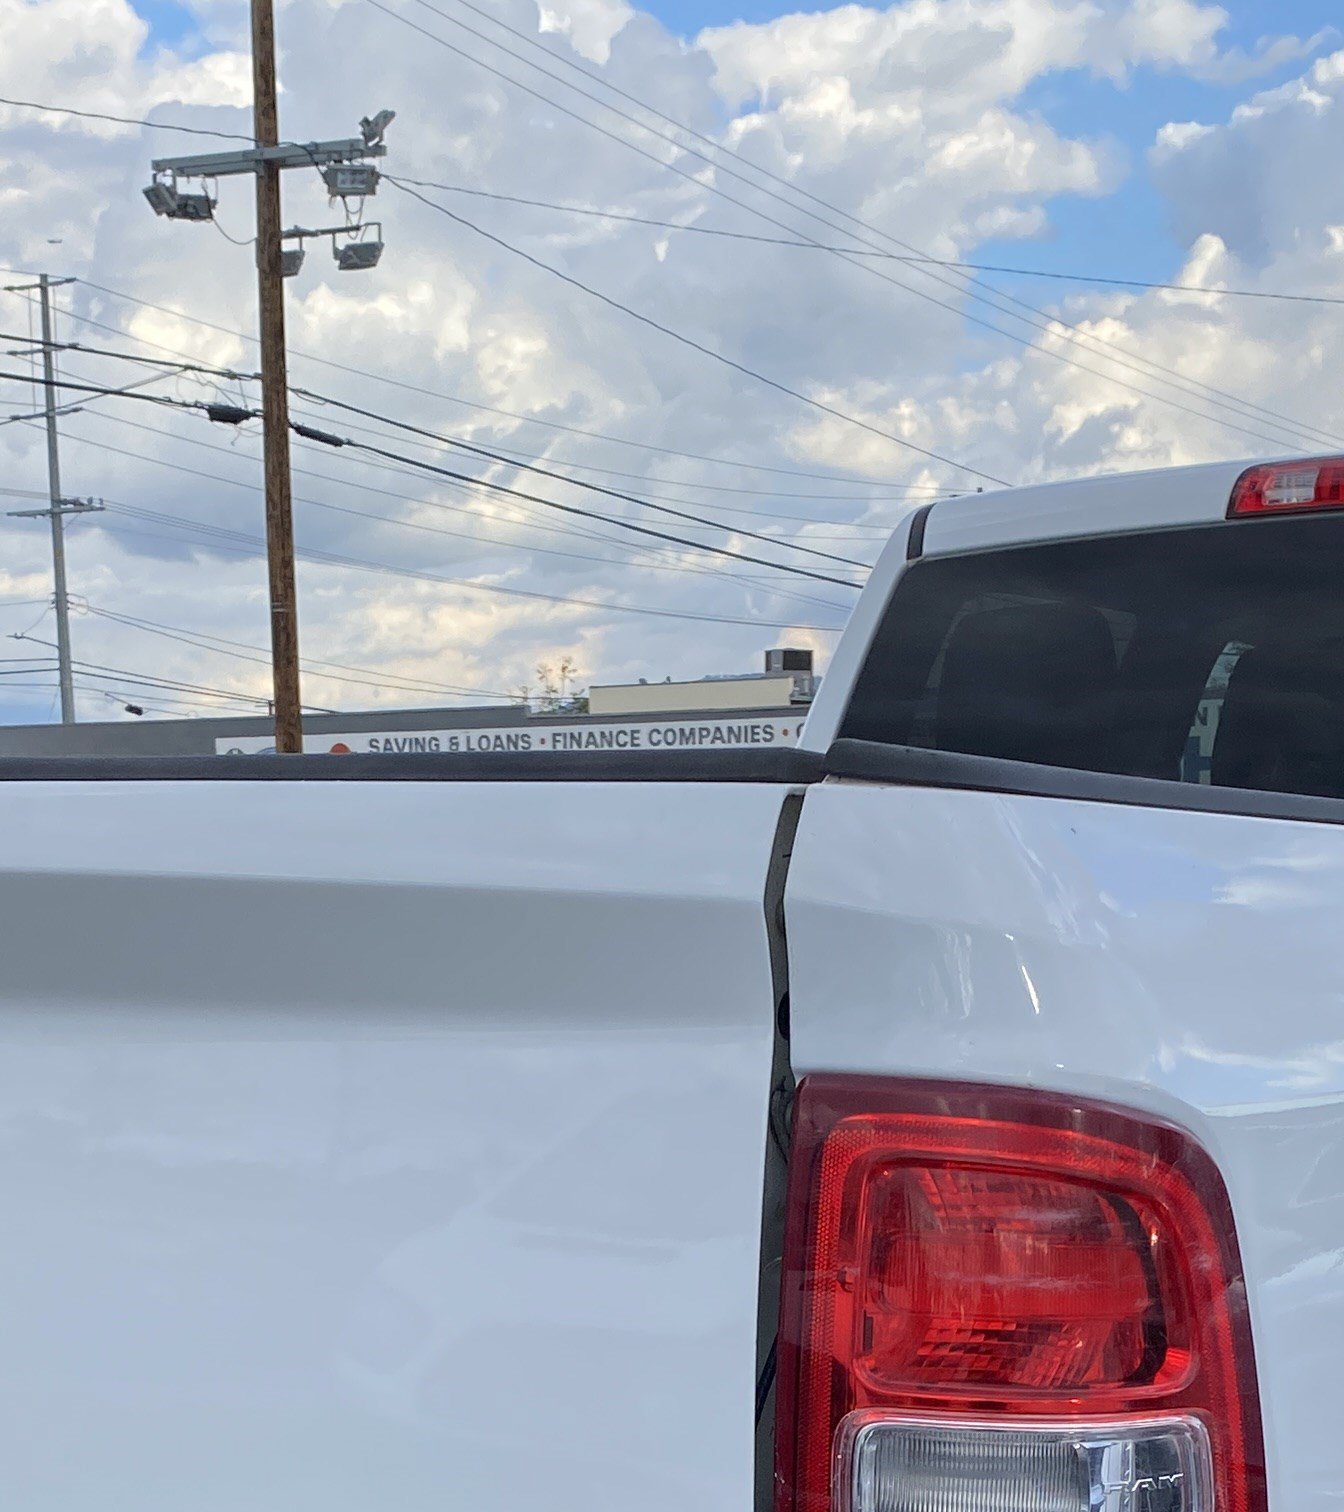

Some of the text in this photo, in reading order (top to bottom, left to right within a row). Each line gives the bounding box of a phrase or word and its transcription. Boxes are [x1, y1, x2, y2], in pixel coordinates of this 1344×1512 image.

[368, 735, 441, 753] SAVING
[466, 732, 533, 752] LOANS
[551, 728, 641, 750] FINANCE
[647, 724, 775, 747] COMPANIES
